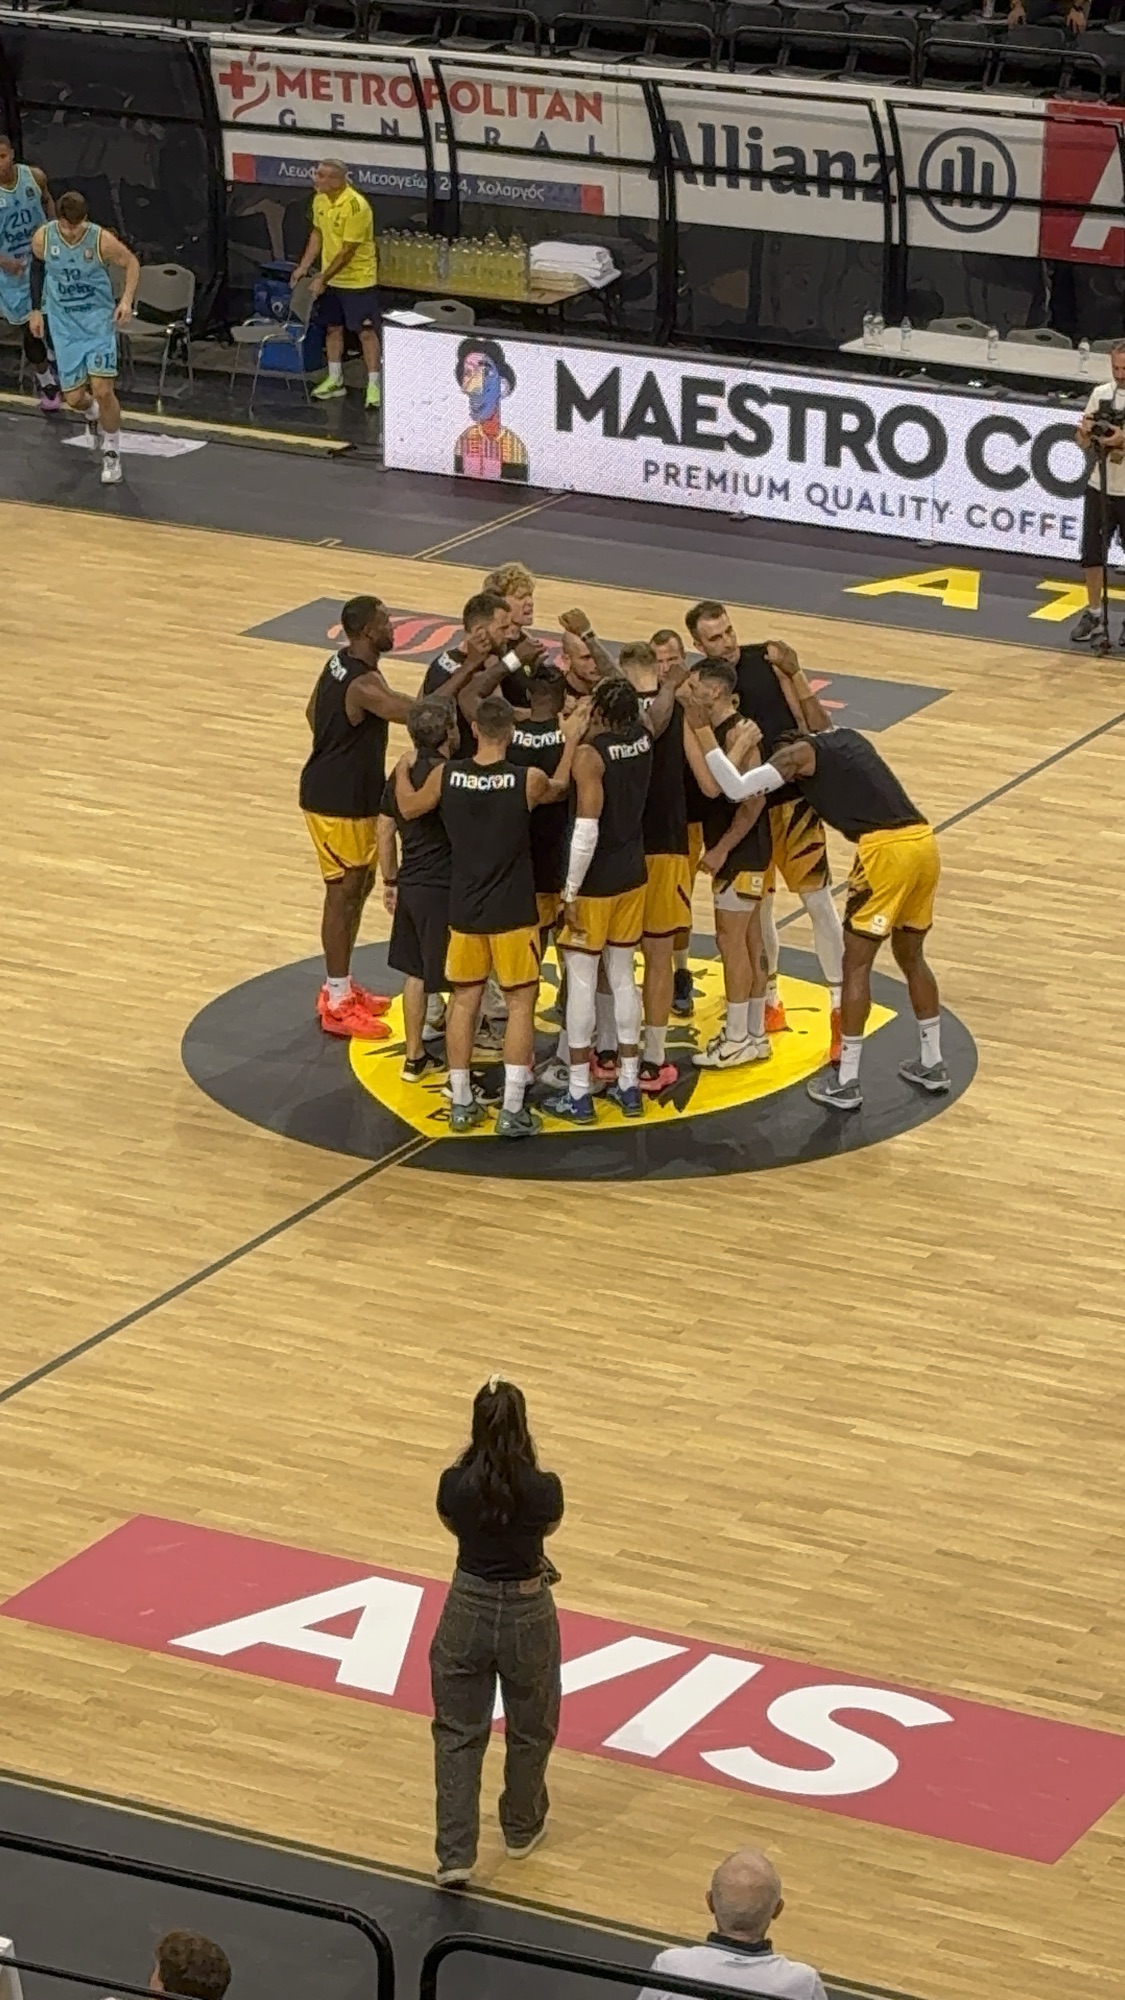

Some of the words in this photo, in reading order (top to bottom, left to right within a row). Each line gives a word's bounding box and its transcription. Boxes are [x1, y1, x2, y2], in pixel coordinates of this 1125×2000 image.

[275, 65, 603, 125] METROPOLITAN
[648, 119, 897, 203] Allianz
[556, 360, 948, 480] MAESTRO
[642, 458, 791, 502] PREMIUM
[804, 482, 951, 524] QUALITY
[965, 504, 1079, 542] COFFE
[449, 770, 516, 791] macron
